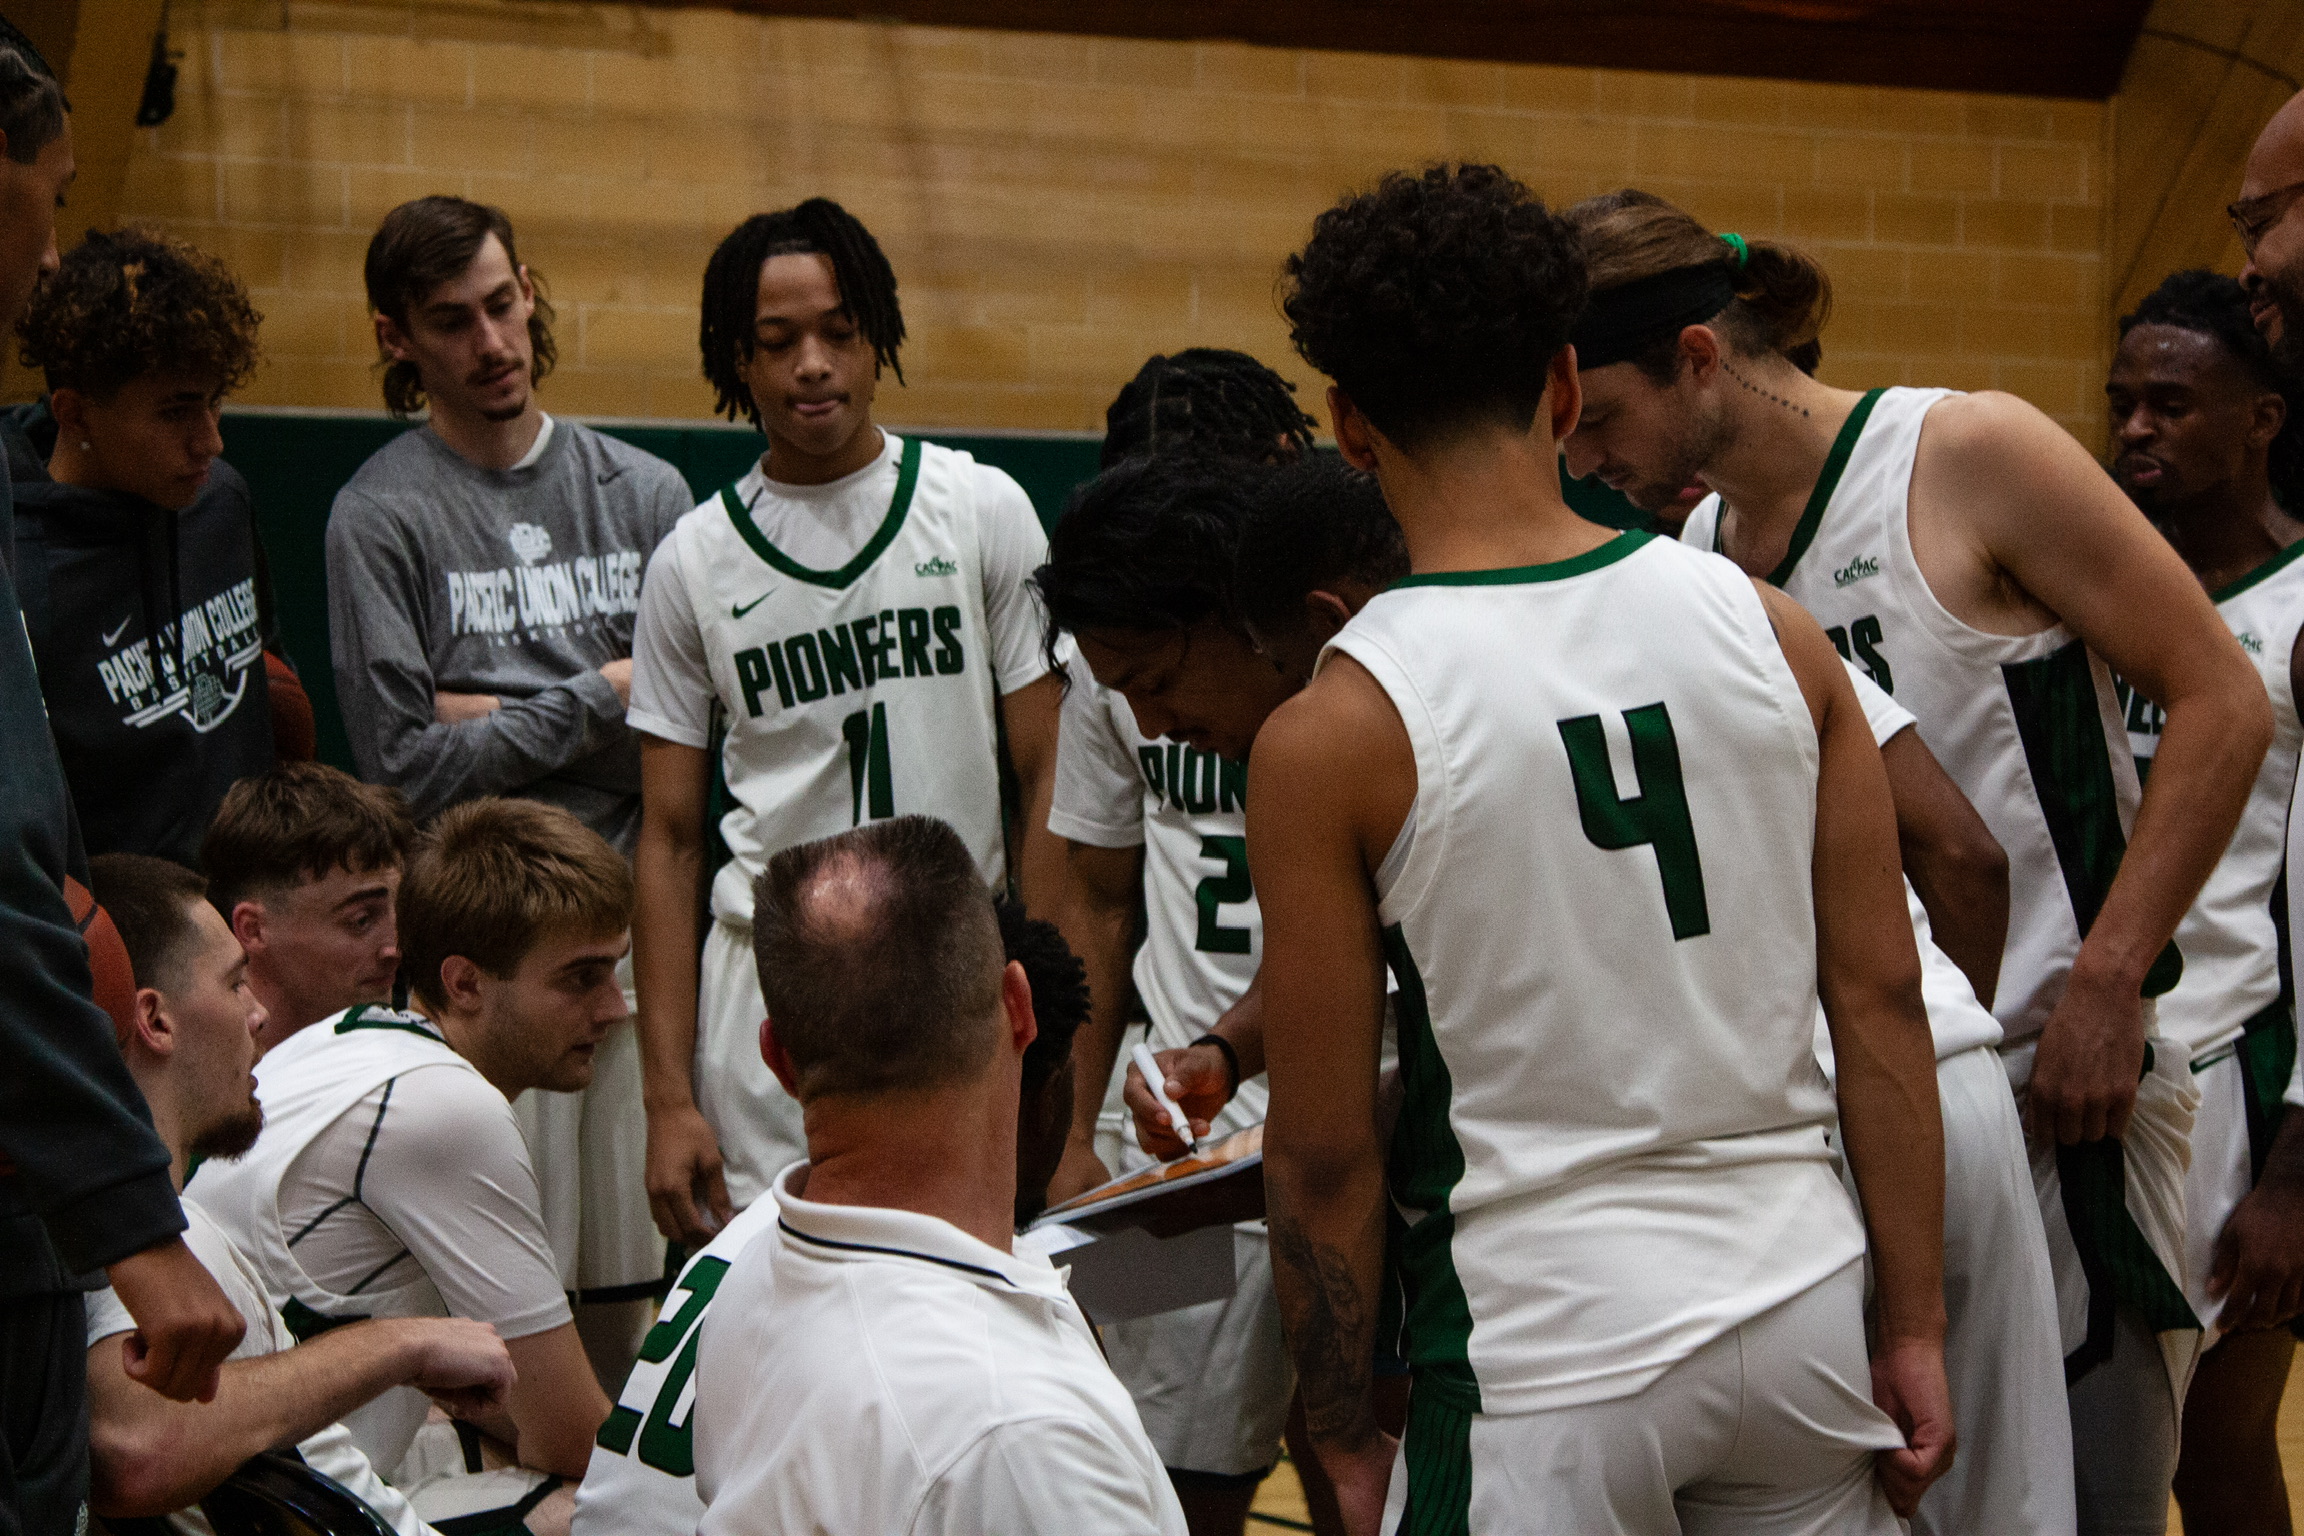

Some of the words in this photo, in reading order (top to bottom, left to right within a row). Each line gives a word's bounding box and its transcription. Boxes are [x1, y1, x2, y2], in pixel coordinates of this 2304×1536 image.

[734, 605, 965, 719] PIONEERS
[842, 701, 895, 827] 11
[1556, 701, 1710, 942] 4
[1195, 835, 1254, 954] 2
